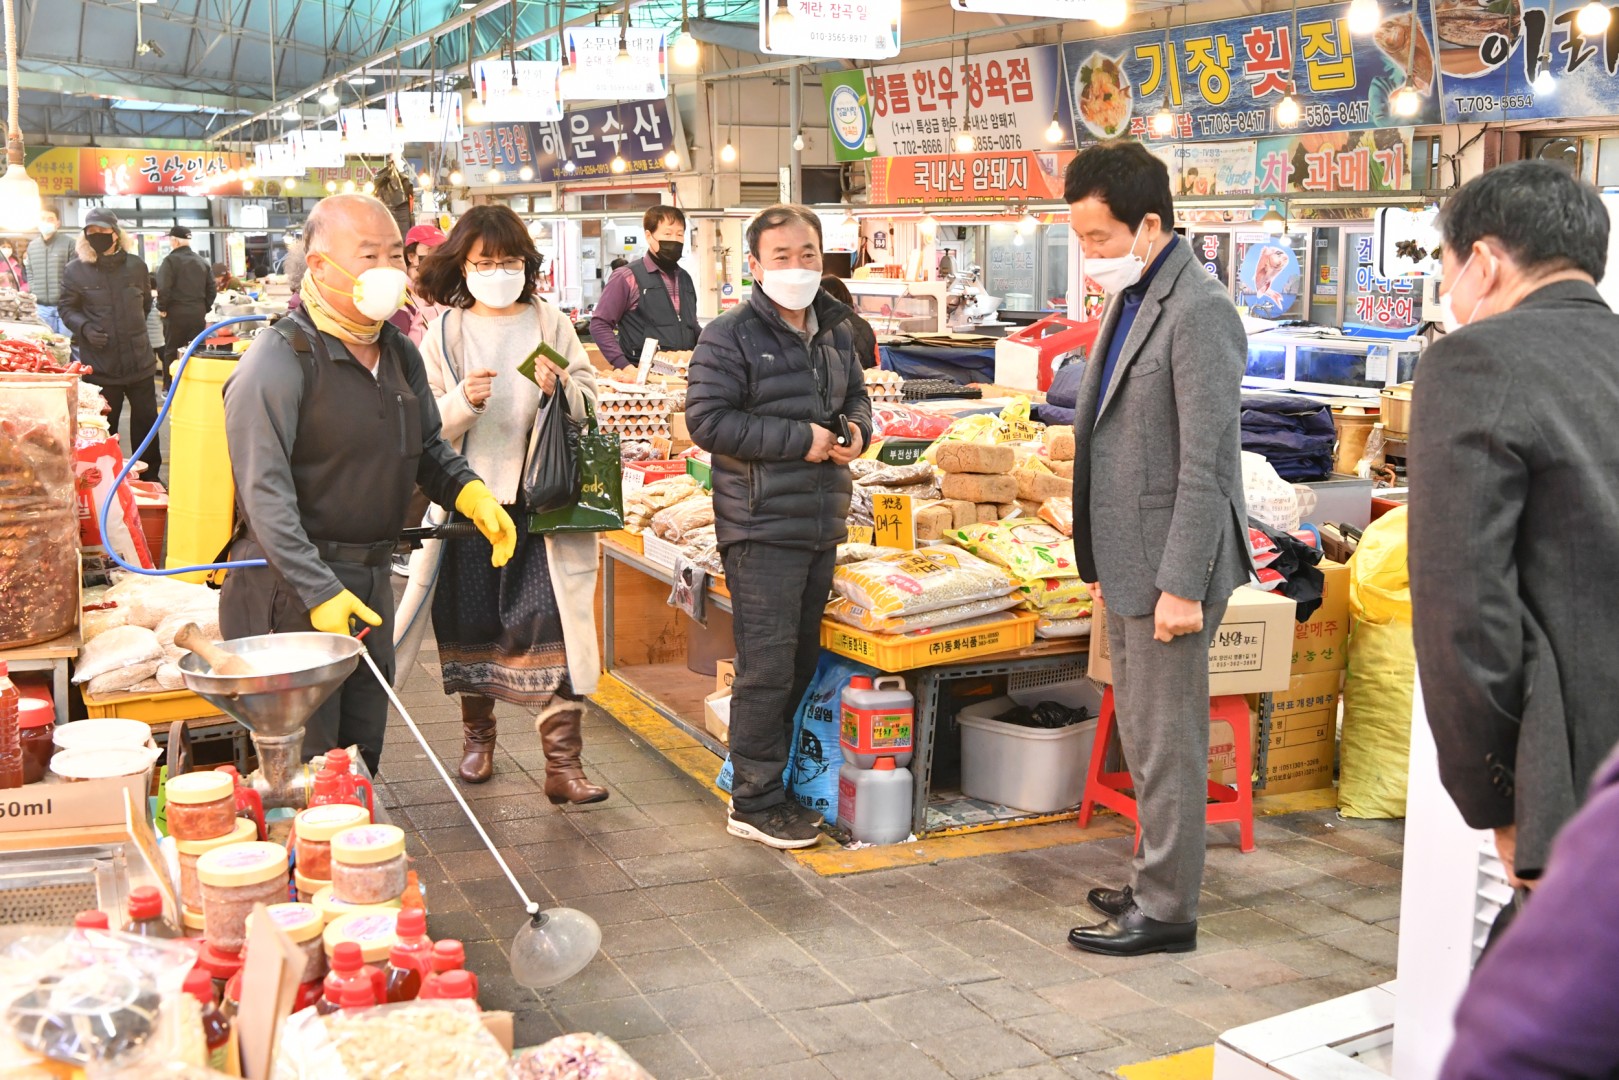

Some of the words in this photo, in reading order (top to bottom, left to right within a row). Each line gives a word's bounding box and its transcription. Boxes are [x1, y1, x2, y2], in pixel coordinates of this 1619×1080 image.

[829, 3, 853, 19] 잡곡
[582, 36, 654, 51] 소문난대집
[866, 73, 910, 118] 명품
[912, 66, 959, 112] 한우
[960, 57, 1034, 109] 정육점
[538, 104, 664, 161] 해운수산
[891, 120, 915, 136] (1++)
[916, 117, 940, 134] 특상급
[1198, 110, 1266, 135] T.703-8417
[893, 138, 943, 155] T.702-8666
[1174, 149, 1191, 158] KBS
[914, 159, 965, 192] 국내산
[1303, 144, 1404, 192] 과메기
[1356, 296, 1413, 324] 개상어
[890, 448, 920, 460] 부전상회
[581, 474, 604, 497] ods
[876, 514, 903, 541] 메주
[929, 635, 977, 655] (주)동화식품
[1219, 631, 1243, 646] 삼양
